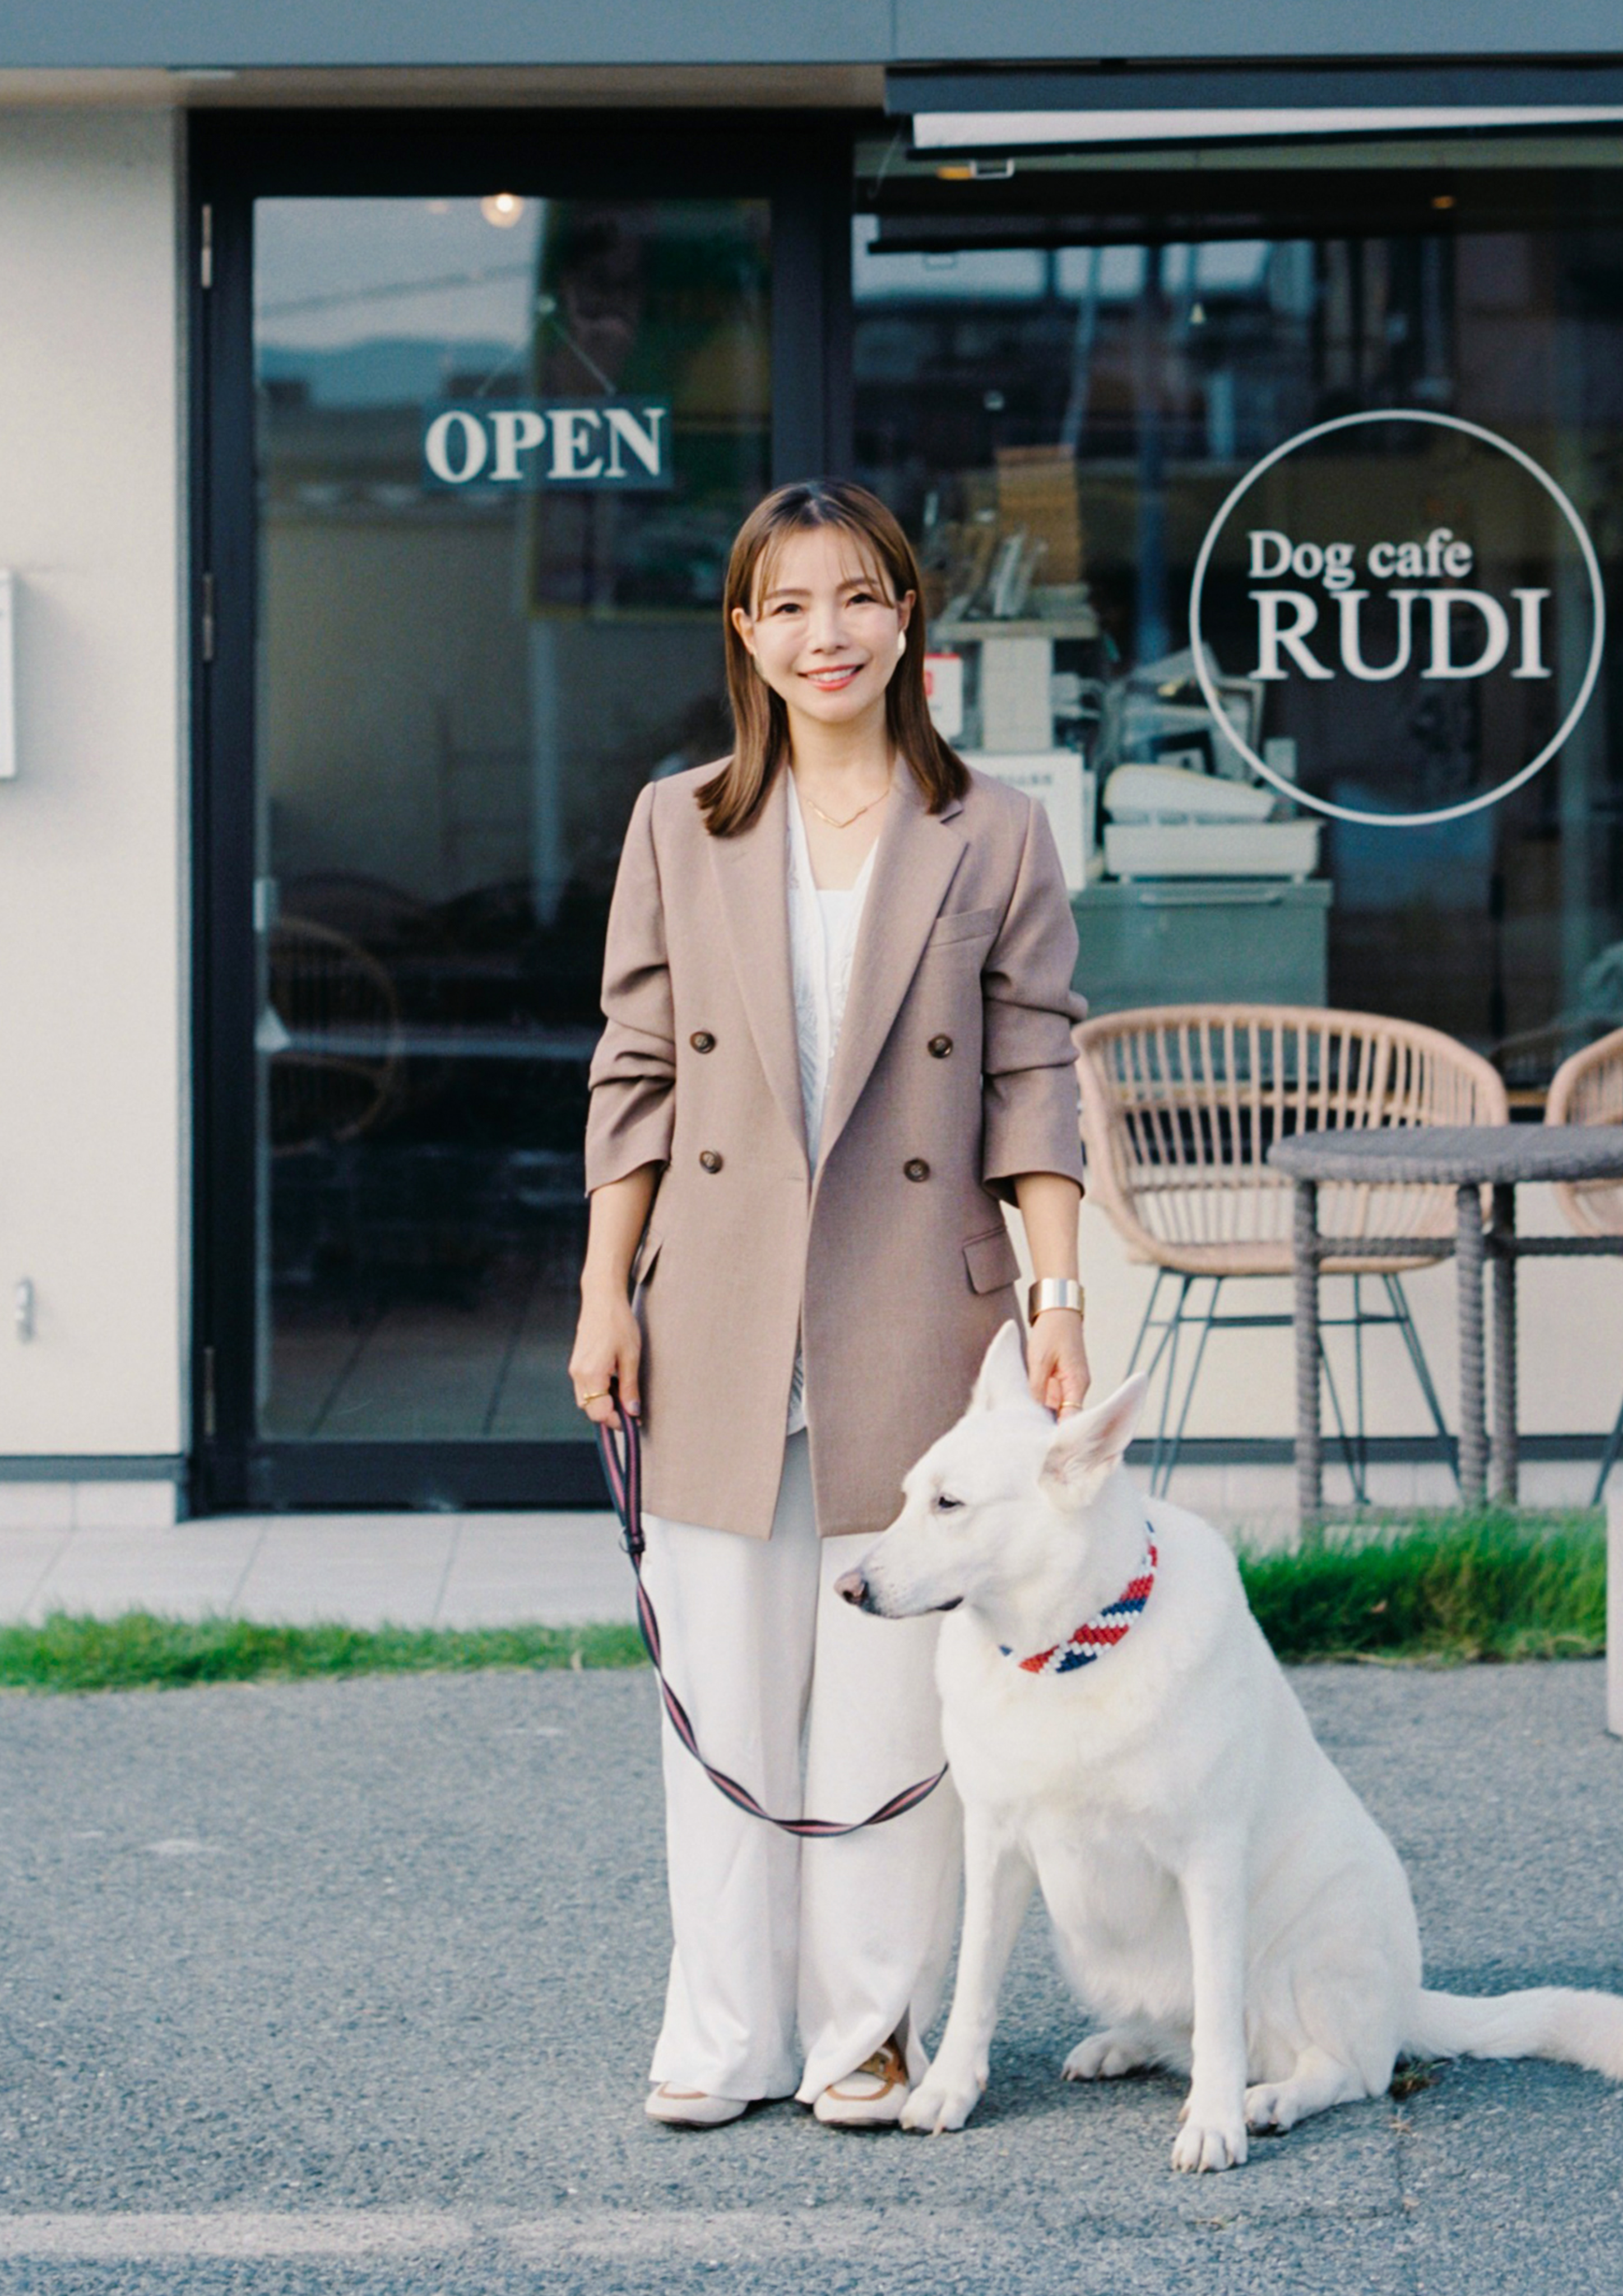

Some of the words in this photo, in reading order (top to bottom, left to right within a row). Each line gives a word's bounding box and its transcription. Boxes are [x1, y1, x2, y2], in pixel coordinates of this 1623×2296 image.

[424, 408, 665, 483] OPEN
[1248, 530, 1356, 591] Dog
[1367, 527, 1473, 578] cafe
[1249, 589, 1551, 681] RUDI
